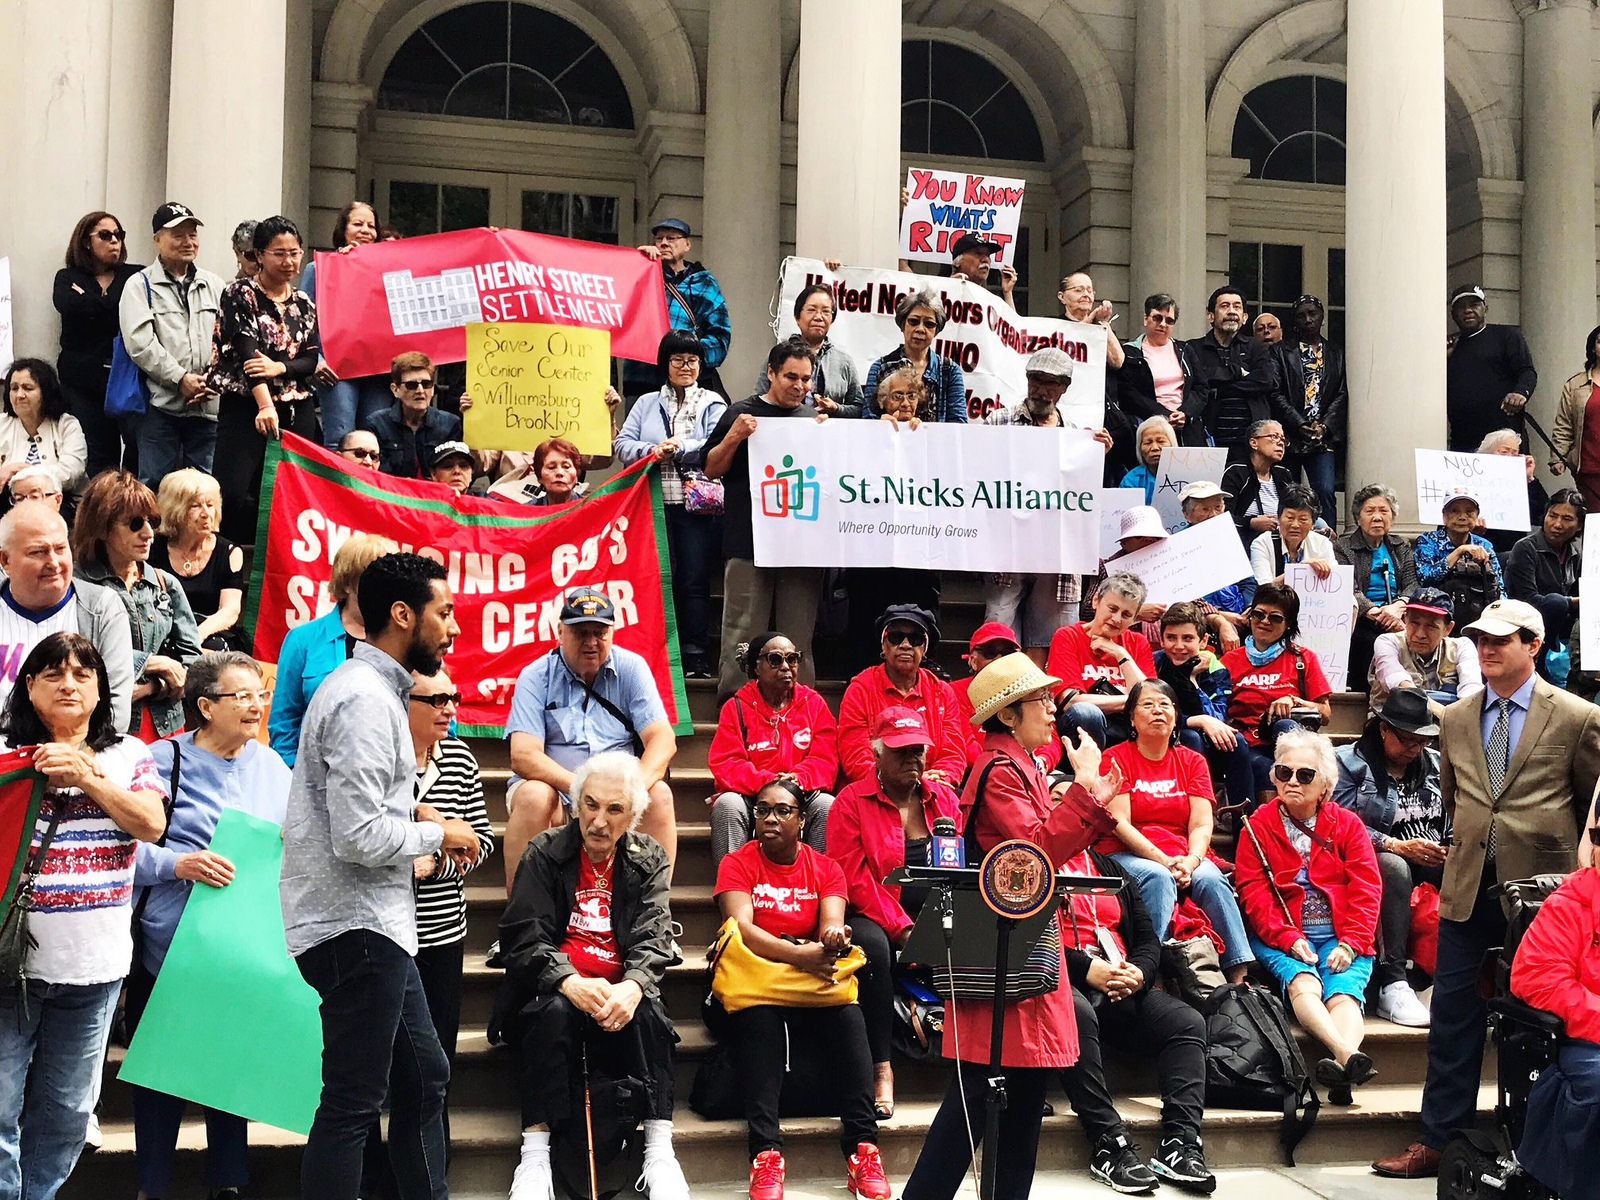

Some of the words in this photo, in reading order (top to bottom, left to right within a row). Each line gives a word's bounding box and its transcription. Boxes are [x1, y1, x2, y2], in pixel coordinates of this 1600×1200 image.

[910, 169, 957, 202] YOU
[963, 175, 1024, 207] KNOW
[929, 202, 997, 231] WHAT'S
[475, 260, 547, 291] HENRY
[547, 267, 617, 300] STREET
[482, 290, 623, 328] SETTLEMENT
[483, 327, 534, 353] Save
[547, 331, 592, 357] Our
[476, 351, 524, 378] Senior
[537, 356, 593, 381] Center
[473, 381, 581, 418] Williamsburg
[505, 406, 580, 438] Brooklyn
[971, 480, 1094, 512] Alliance
[838, 520, 875, 534] Where
[878, 521, 942, 539] Opportunity
[944, 524, 978, 538] Grows
[1292, 567, 1343, 593] FUND
[1298, 613, 1350, 632] ENIOR
[1235, 673, 1281, 687] AARP
[776, 900, 801, 912] York
